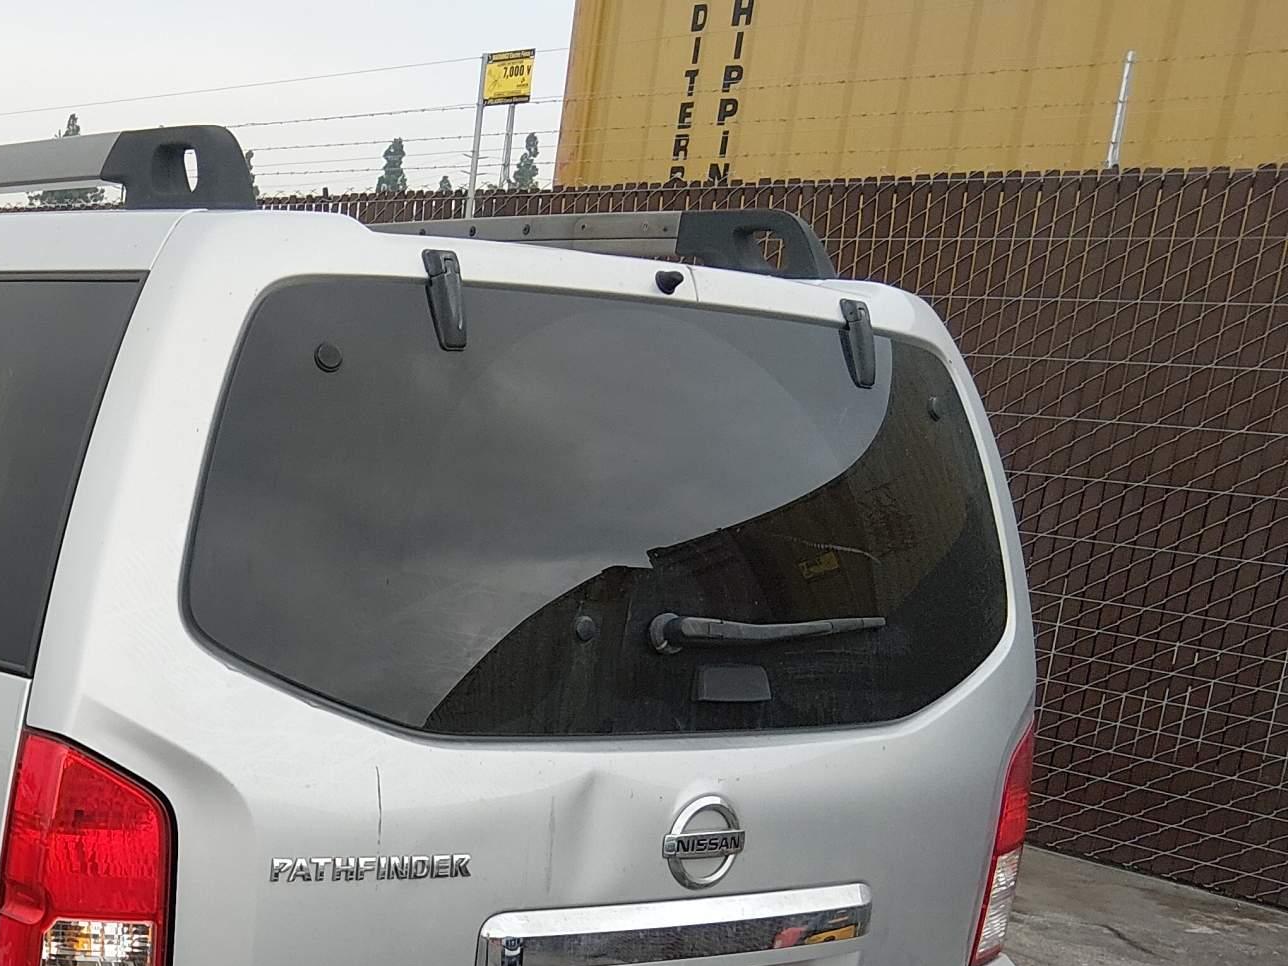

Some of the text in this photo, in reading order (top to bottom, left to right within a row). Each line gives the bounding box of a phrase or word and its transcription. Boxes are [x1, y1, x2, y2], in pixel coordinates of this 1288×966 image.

[503, 64, 525, 79] 7,000
[675, 835, 741, 853] NISSAN
[270, 854, 472, 882] PATHFINDER
